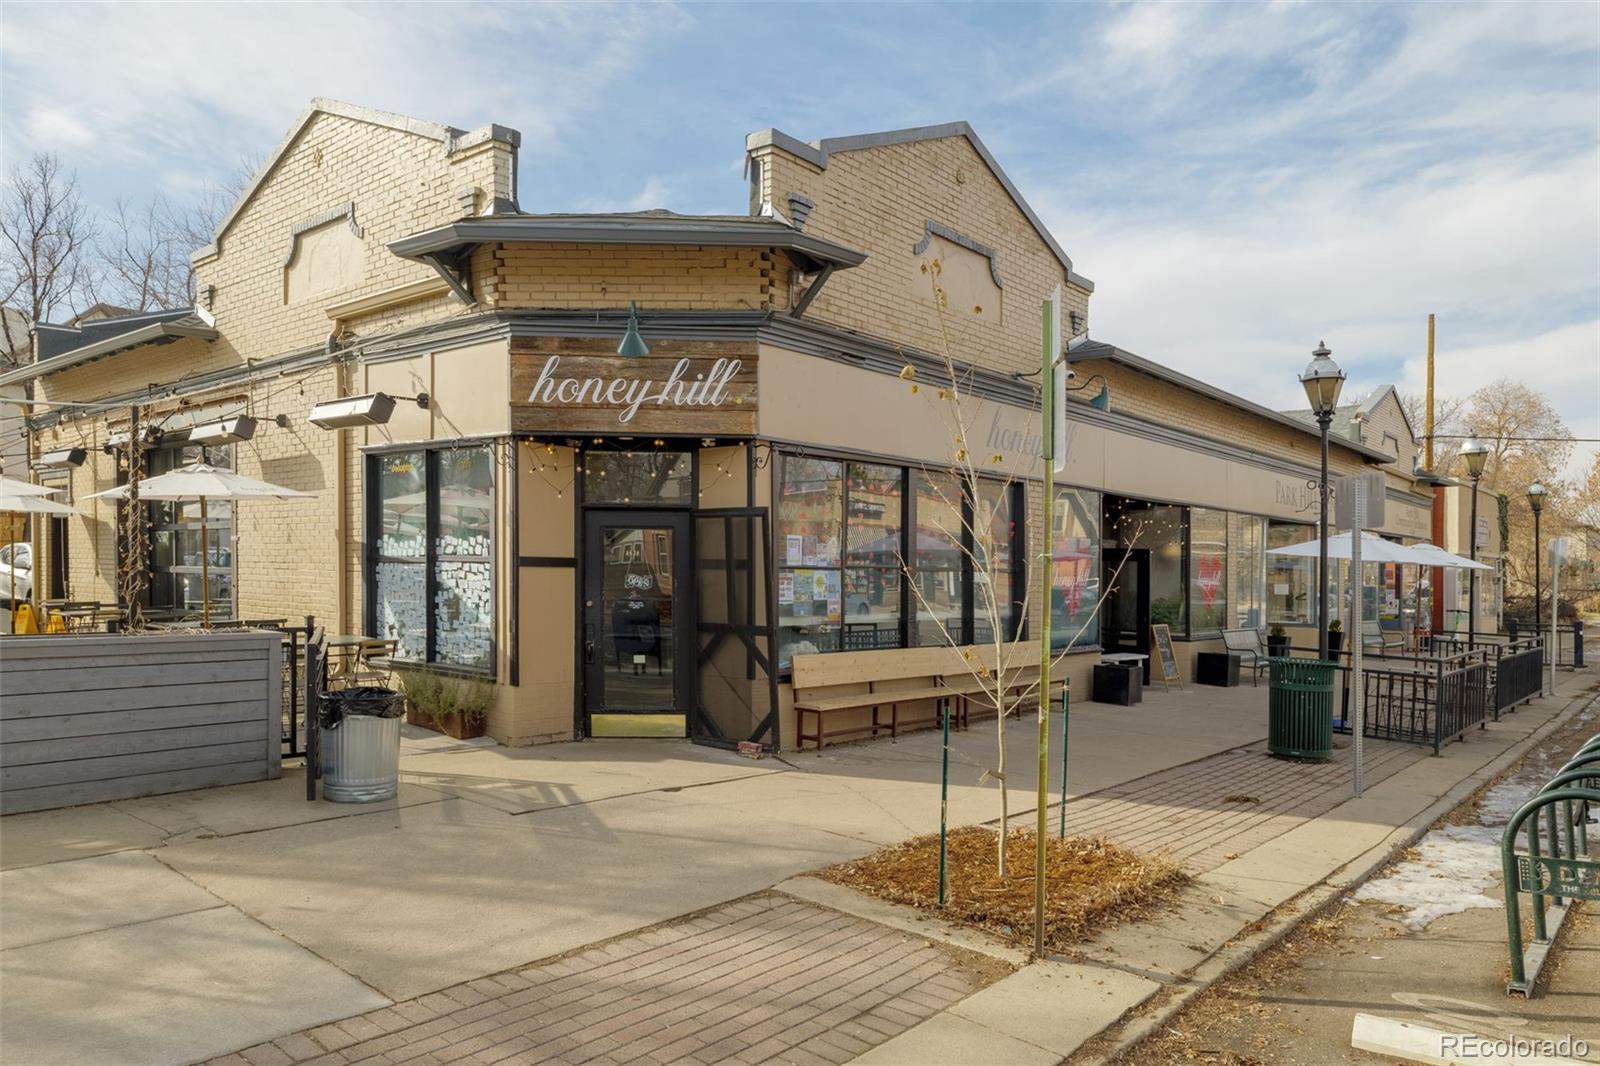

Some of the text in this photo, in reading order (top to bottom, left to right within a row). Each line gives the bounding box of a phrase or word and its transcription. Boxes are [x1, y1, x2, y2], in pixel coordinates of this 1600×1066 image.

[528, 355, 742, 423] honey hill
[1275, 479, 1298, 507] PARK
